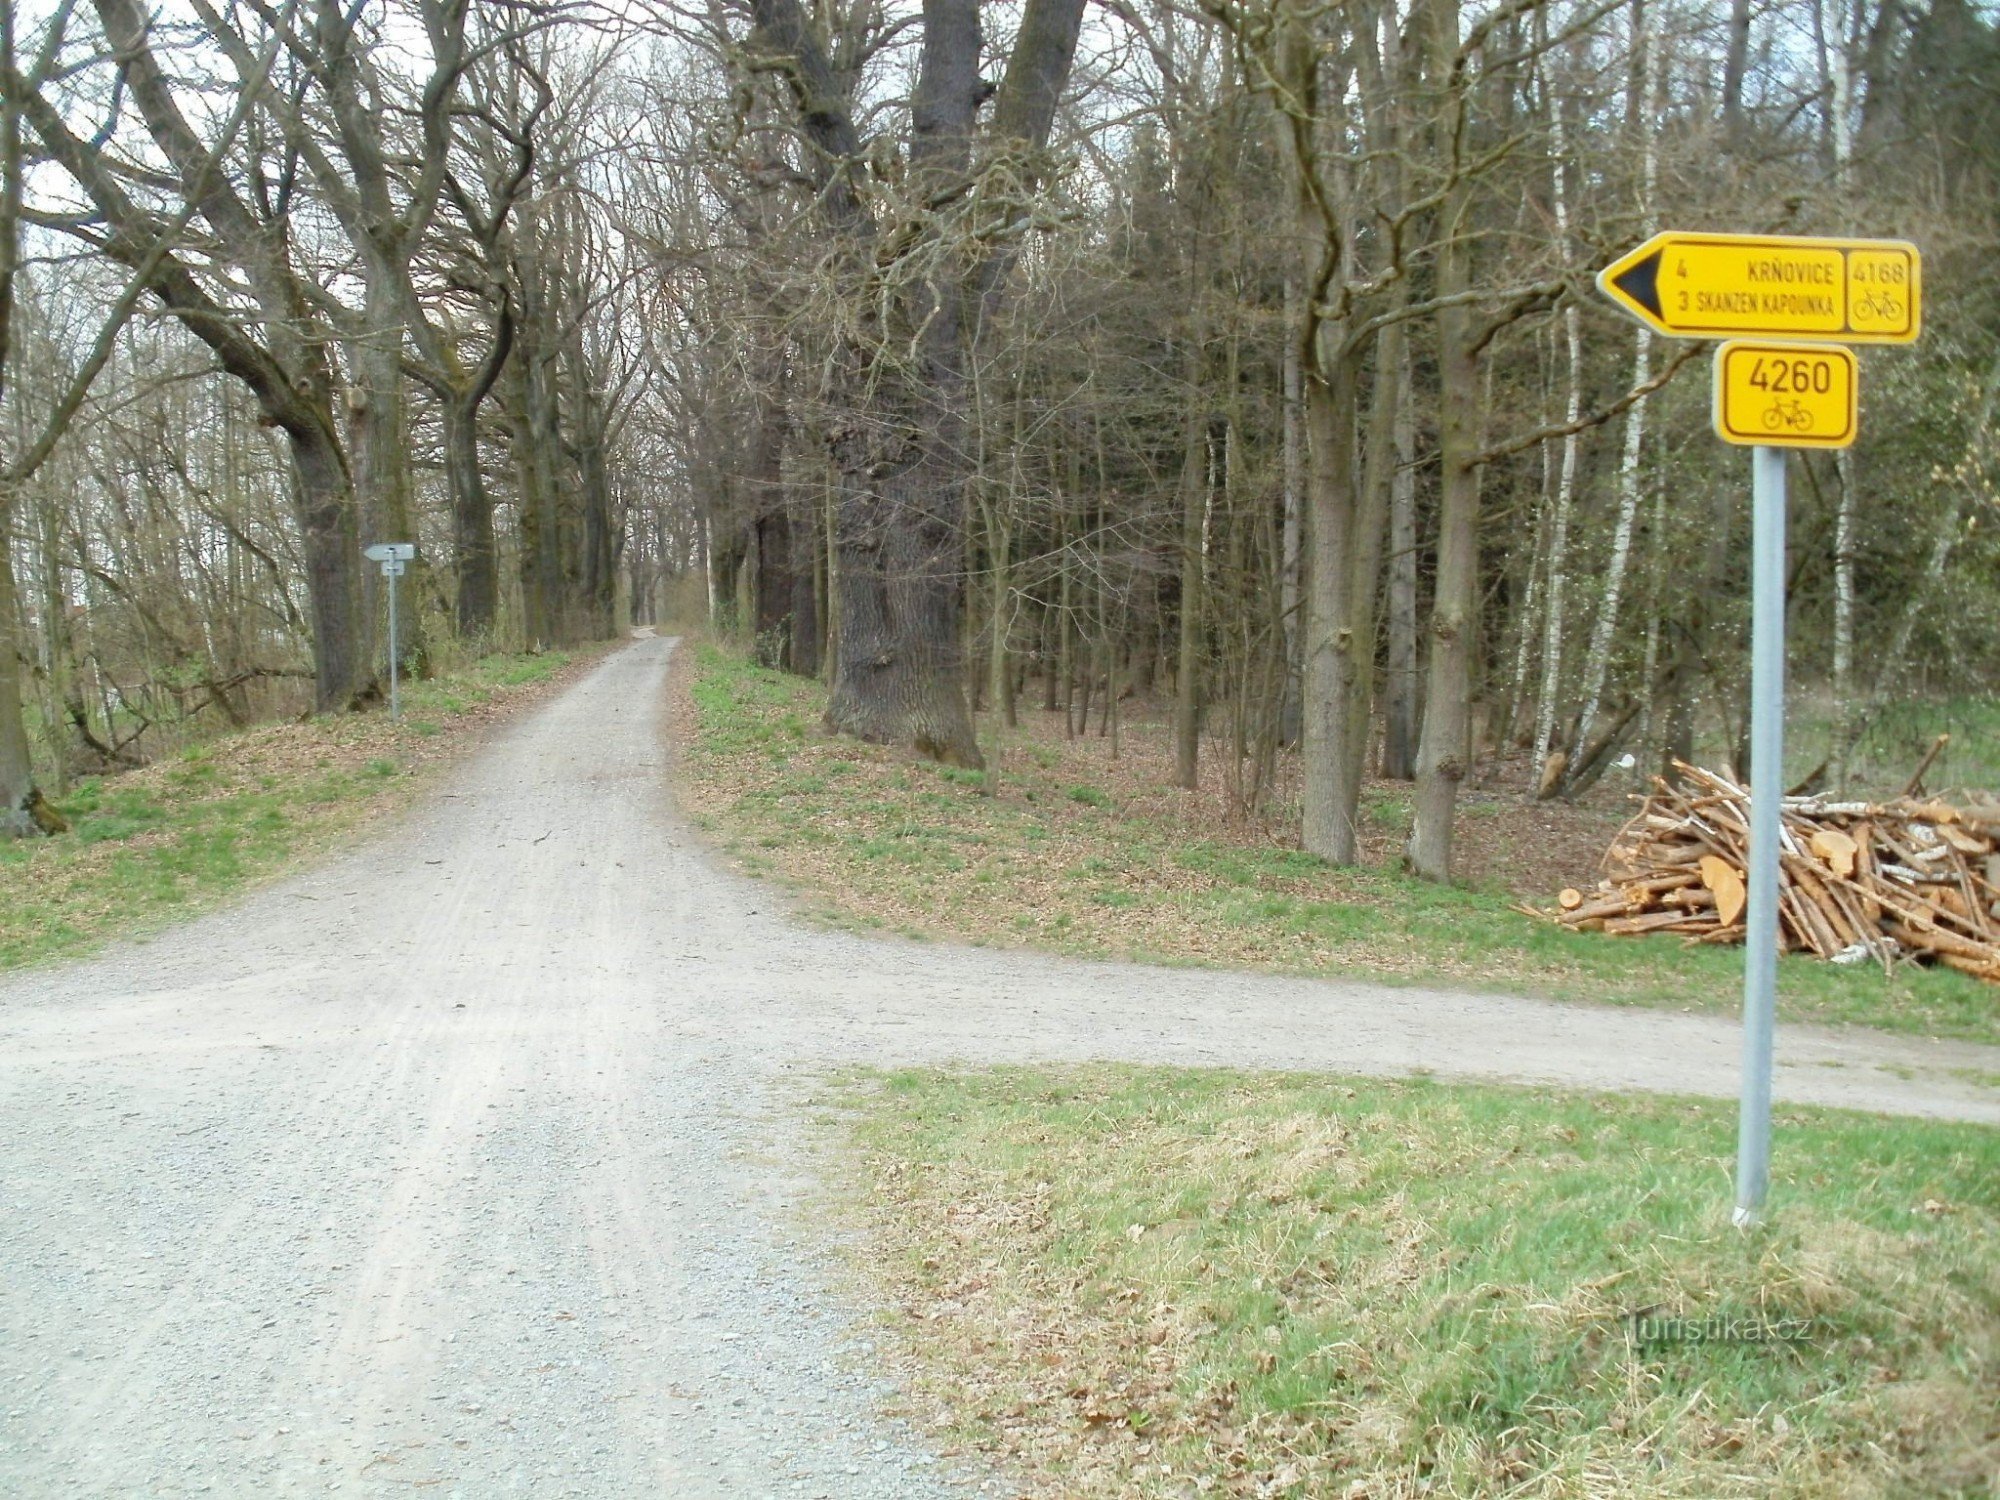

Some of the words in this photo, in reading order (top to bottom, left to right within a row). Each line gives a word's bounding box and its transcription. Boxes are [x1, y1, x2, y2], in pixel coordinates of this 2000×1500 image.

[1676, 258, 1688, 279] 4
[1747, 257, 1835, 285] KRŇOVICE
[1853, 261, 1905, 285] 4168
[1678, 290, 1689, 312] 3
[1696, 290, 1758, 315] SKANZEN
[1749, 358, 1831, 394] 4260
